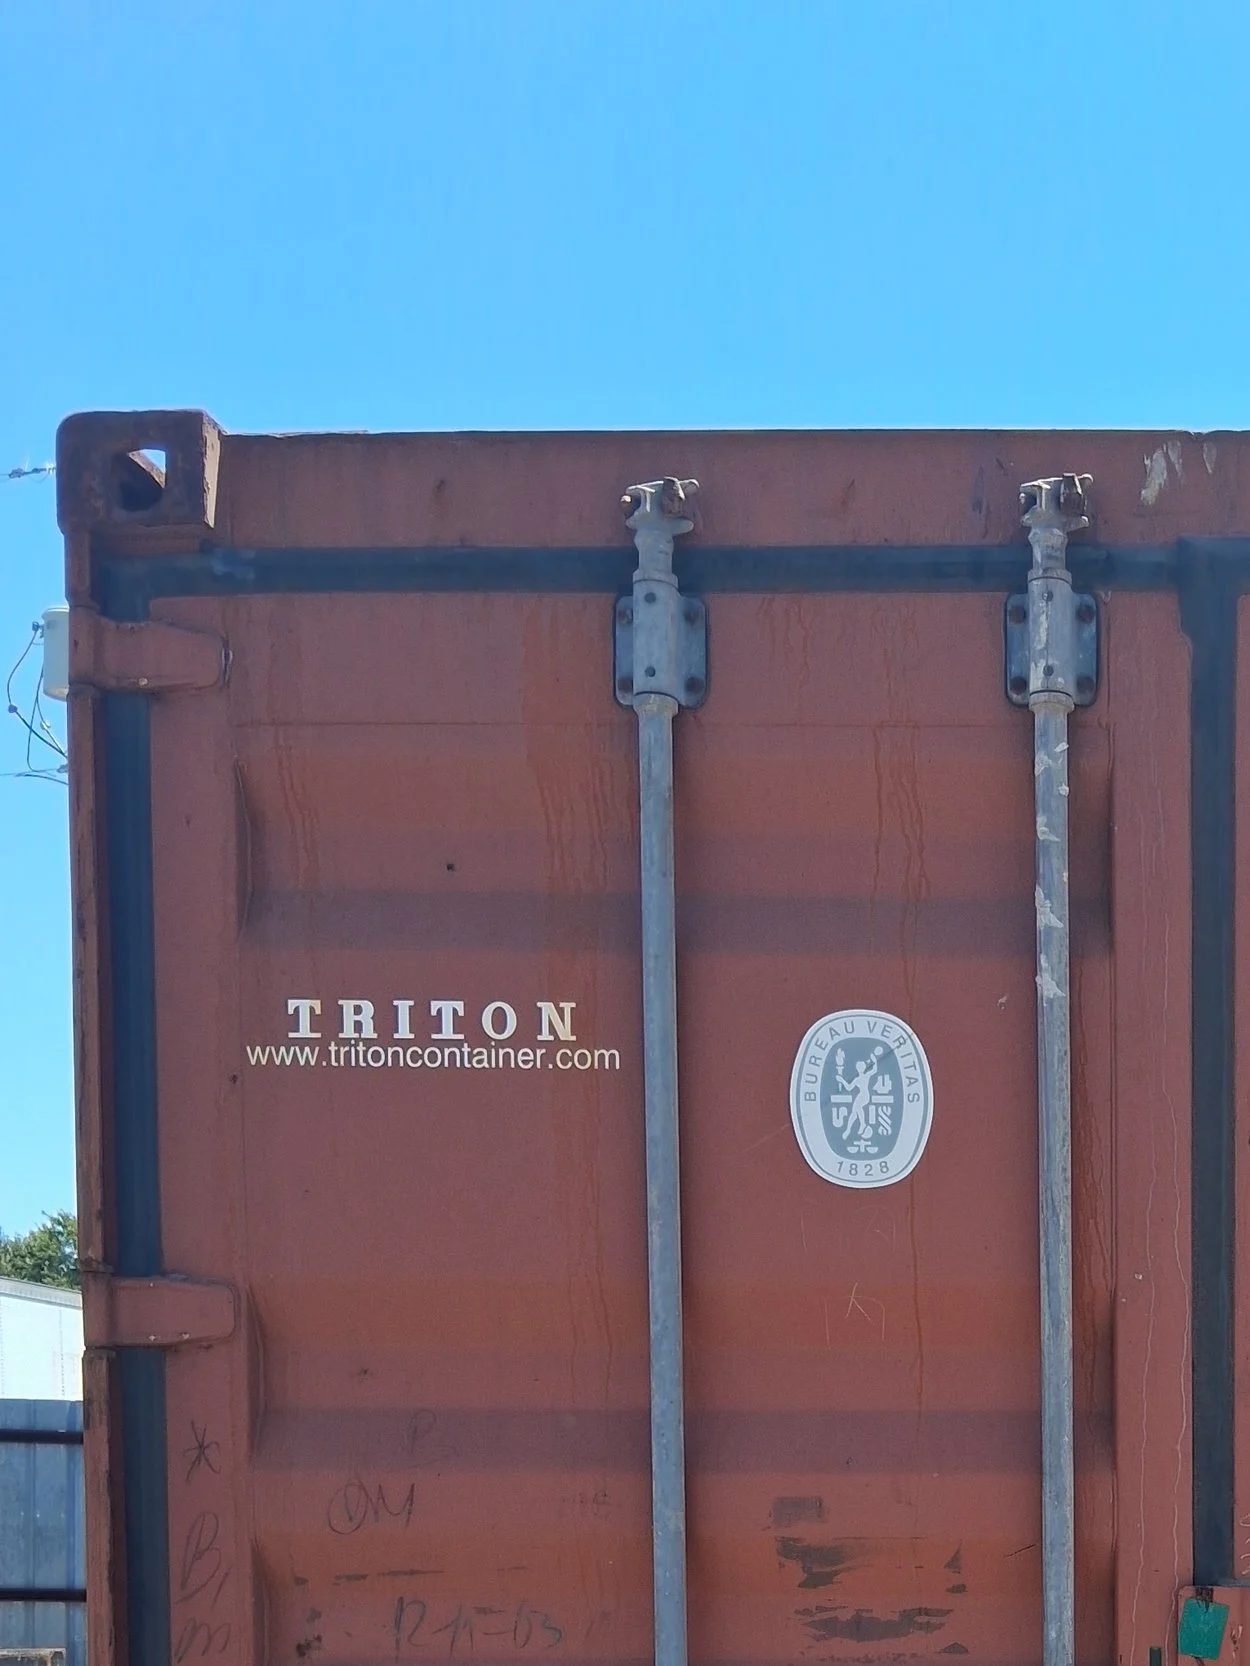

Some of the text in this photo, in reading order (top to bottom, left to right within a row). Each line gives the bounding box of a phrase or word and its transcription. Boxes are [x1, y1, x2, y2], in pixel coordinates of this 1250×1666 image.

[287, 998, 577, 1042] TRITON
[247, 1039, 621, 1071] www.tritoncontainer.com
[804, 1020, 920, 1104] BUREAU VERITAS
[836, 1160, 890, 1177] 1828
